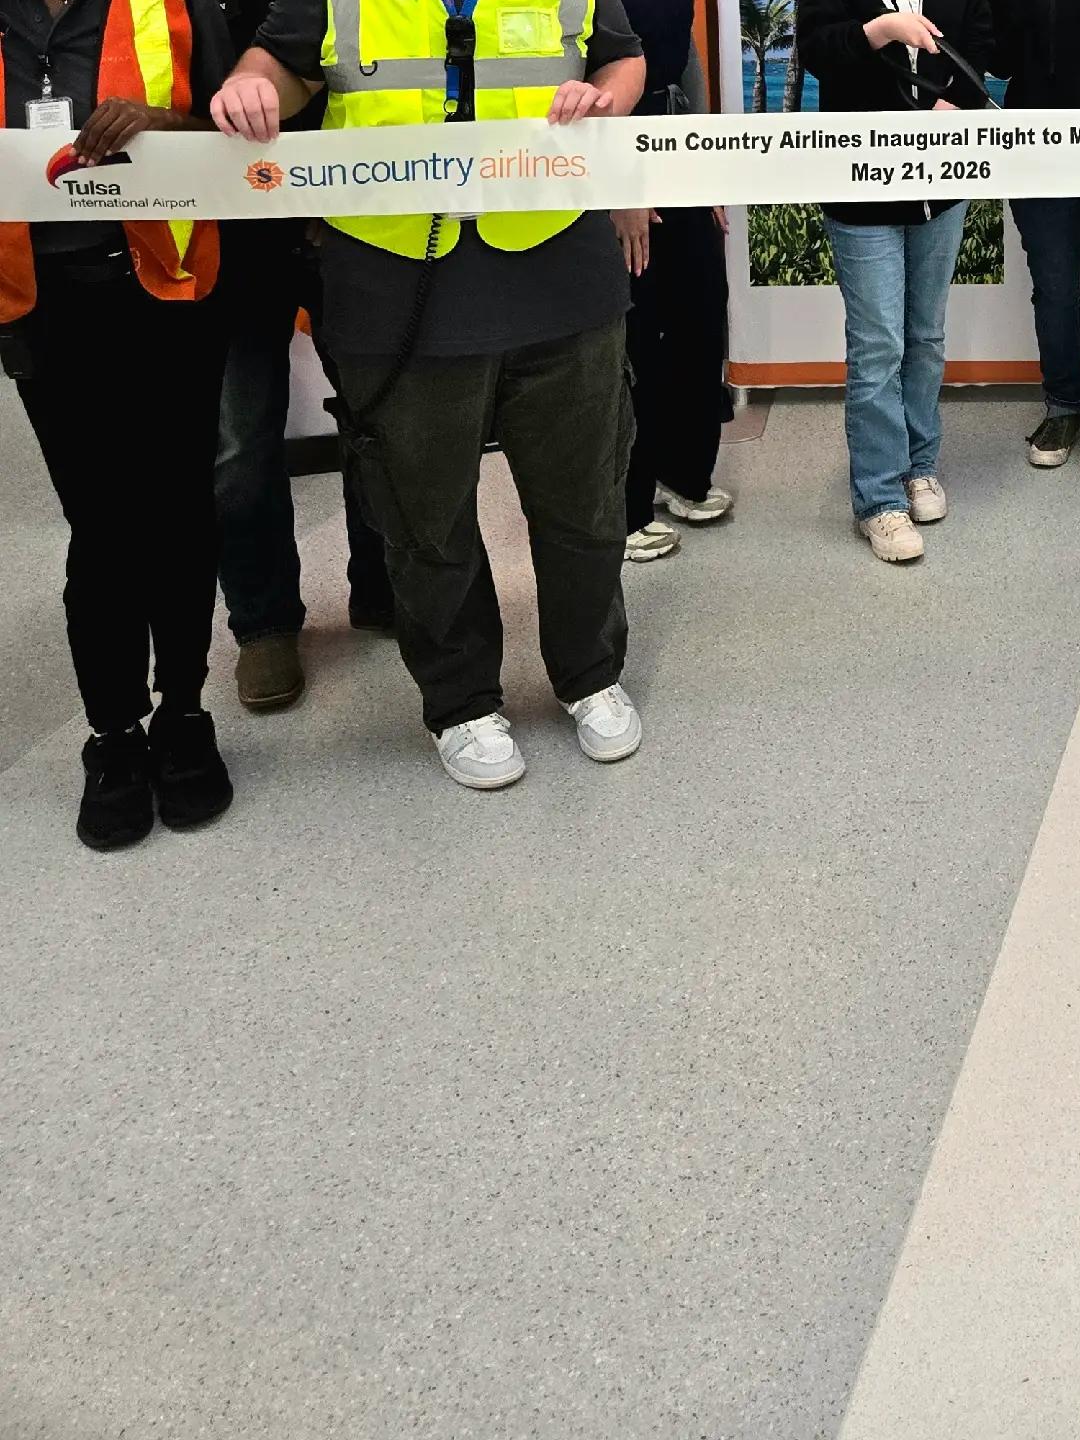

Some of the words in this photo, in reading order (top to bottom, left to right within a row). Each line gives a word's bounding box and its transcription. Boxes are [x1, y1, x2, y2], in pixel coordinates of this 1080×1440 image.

[636, 133, 677, 152] Sun
[685, 131, 773, 154] Country
[780, 130, 862, 149] Airlines
[870, 128, 969, 151] Inaugural
[977, 127, 1035, 150] Flight
[1043, 127, 1062, 145] to
[290, 164, 347, 188] sun
[352, 152, 474, 186] country
[851, 162, 895, 186] May
[901, 161, 933, 184] 21,
[940, 160, 991, 180] 2026
[63, 180, 121, 195] Tulsa
[70, 197, 149, 208] International
[153, 197, 196, 209] Airport
